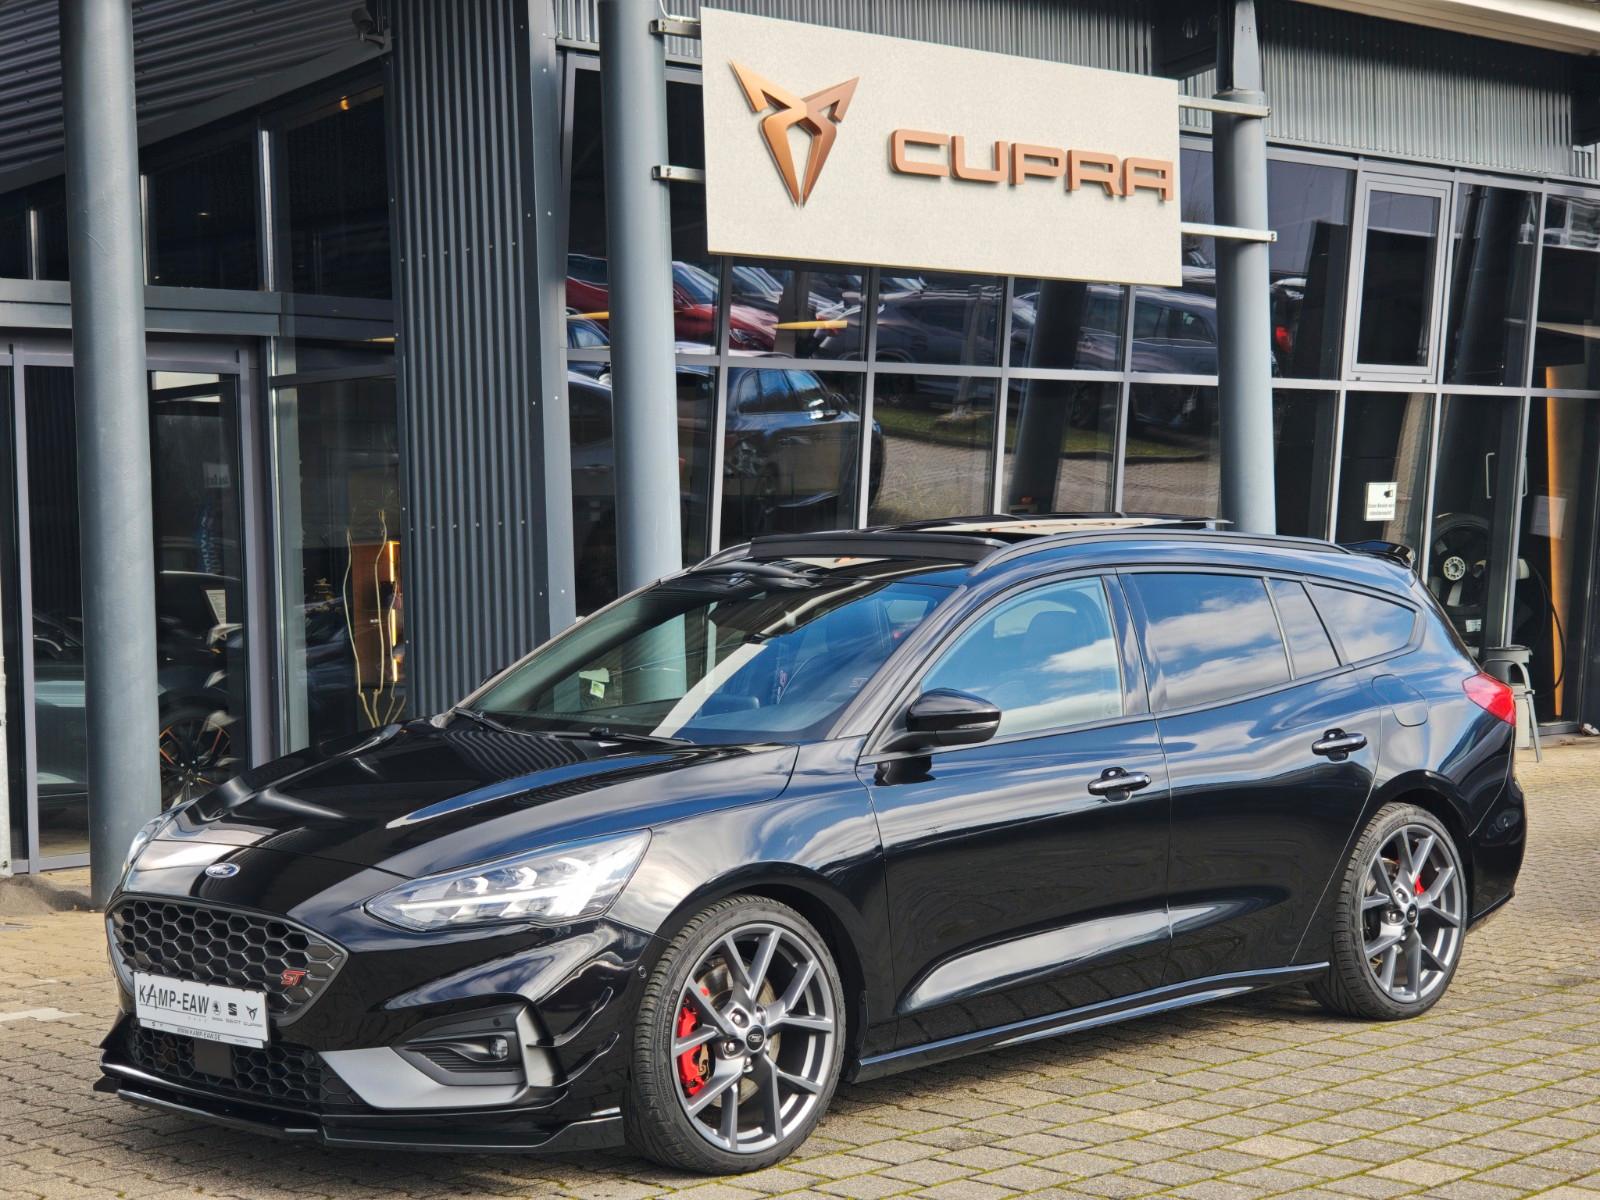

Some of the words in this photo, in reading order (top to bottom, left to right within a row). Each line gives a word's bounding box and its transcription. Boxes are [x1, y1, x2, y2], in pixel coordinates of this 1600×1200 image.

[890, 128, 1175, 203] CUPRA
[280, 968, 307, 987] ST
[138, 983, 210, 1015] KAMP-EAW
